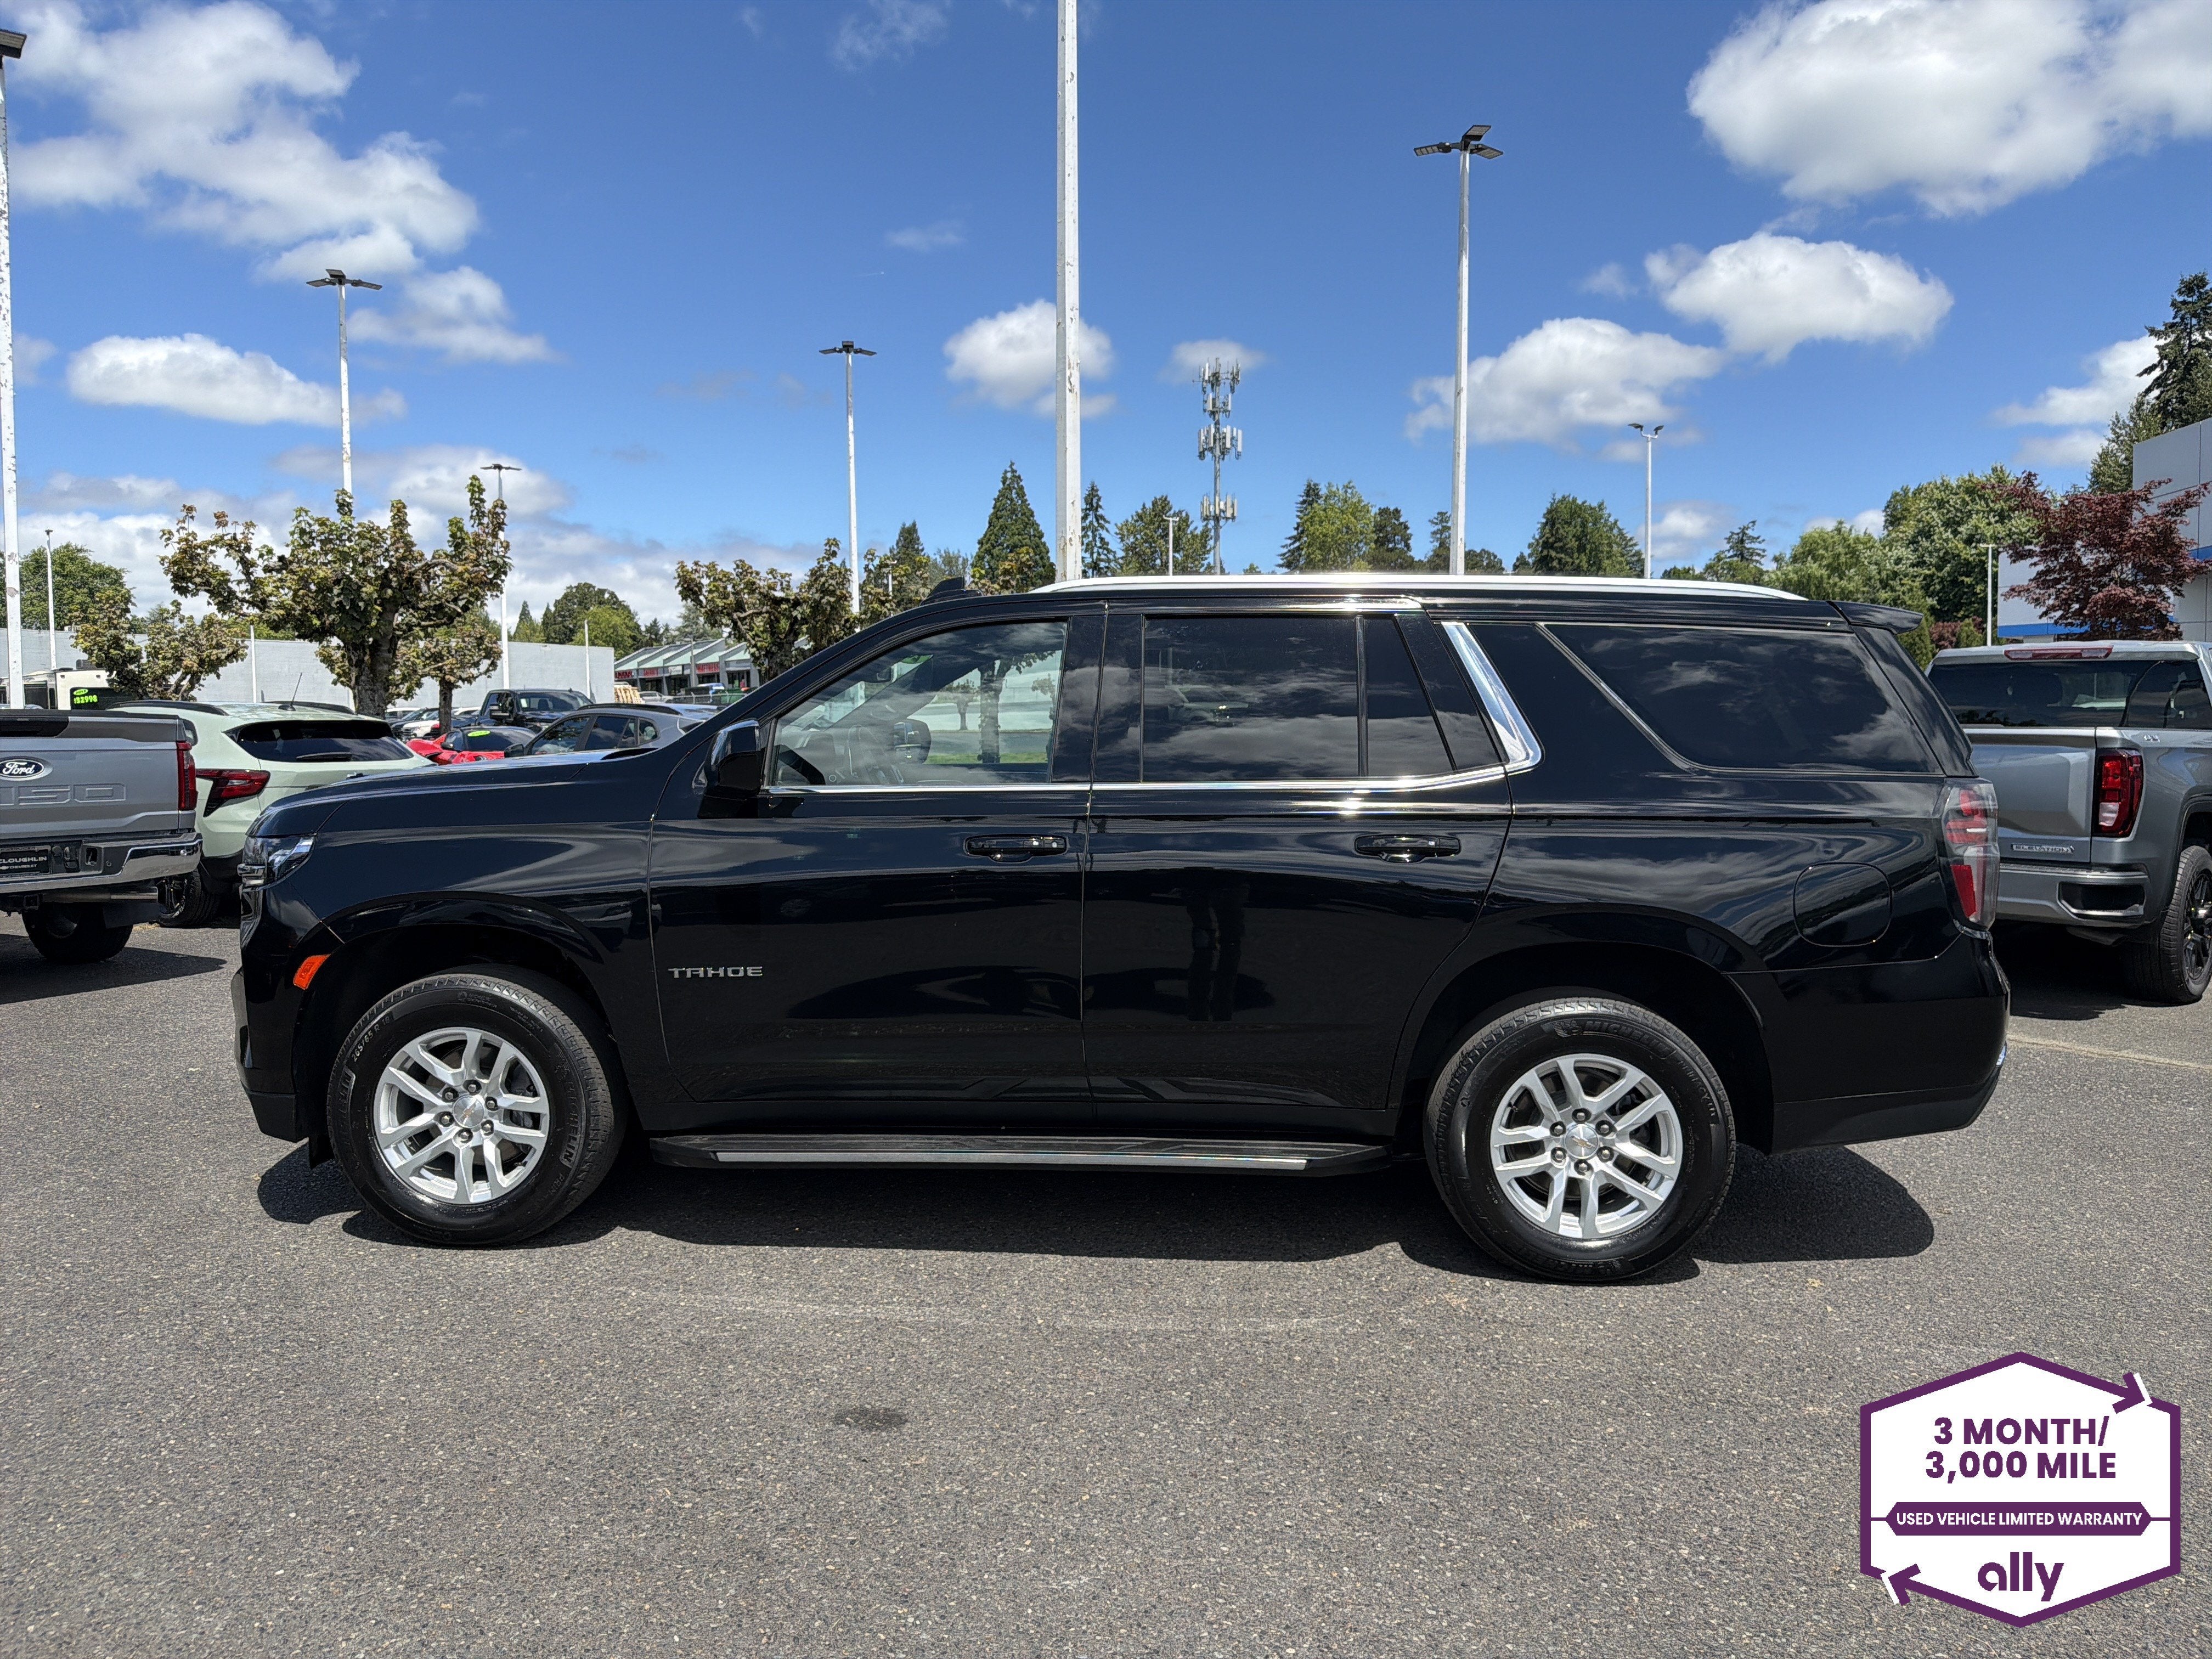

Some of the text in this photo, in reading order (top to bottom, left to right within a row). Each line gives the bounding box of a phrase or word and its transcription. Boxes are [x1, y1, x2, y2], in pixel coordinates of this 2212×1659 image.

[2, 761, 35, 774] Ford
[2014, 845, 2070, 854] ELEVATION
[668, 967, 763, 979] TAHOE
